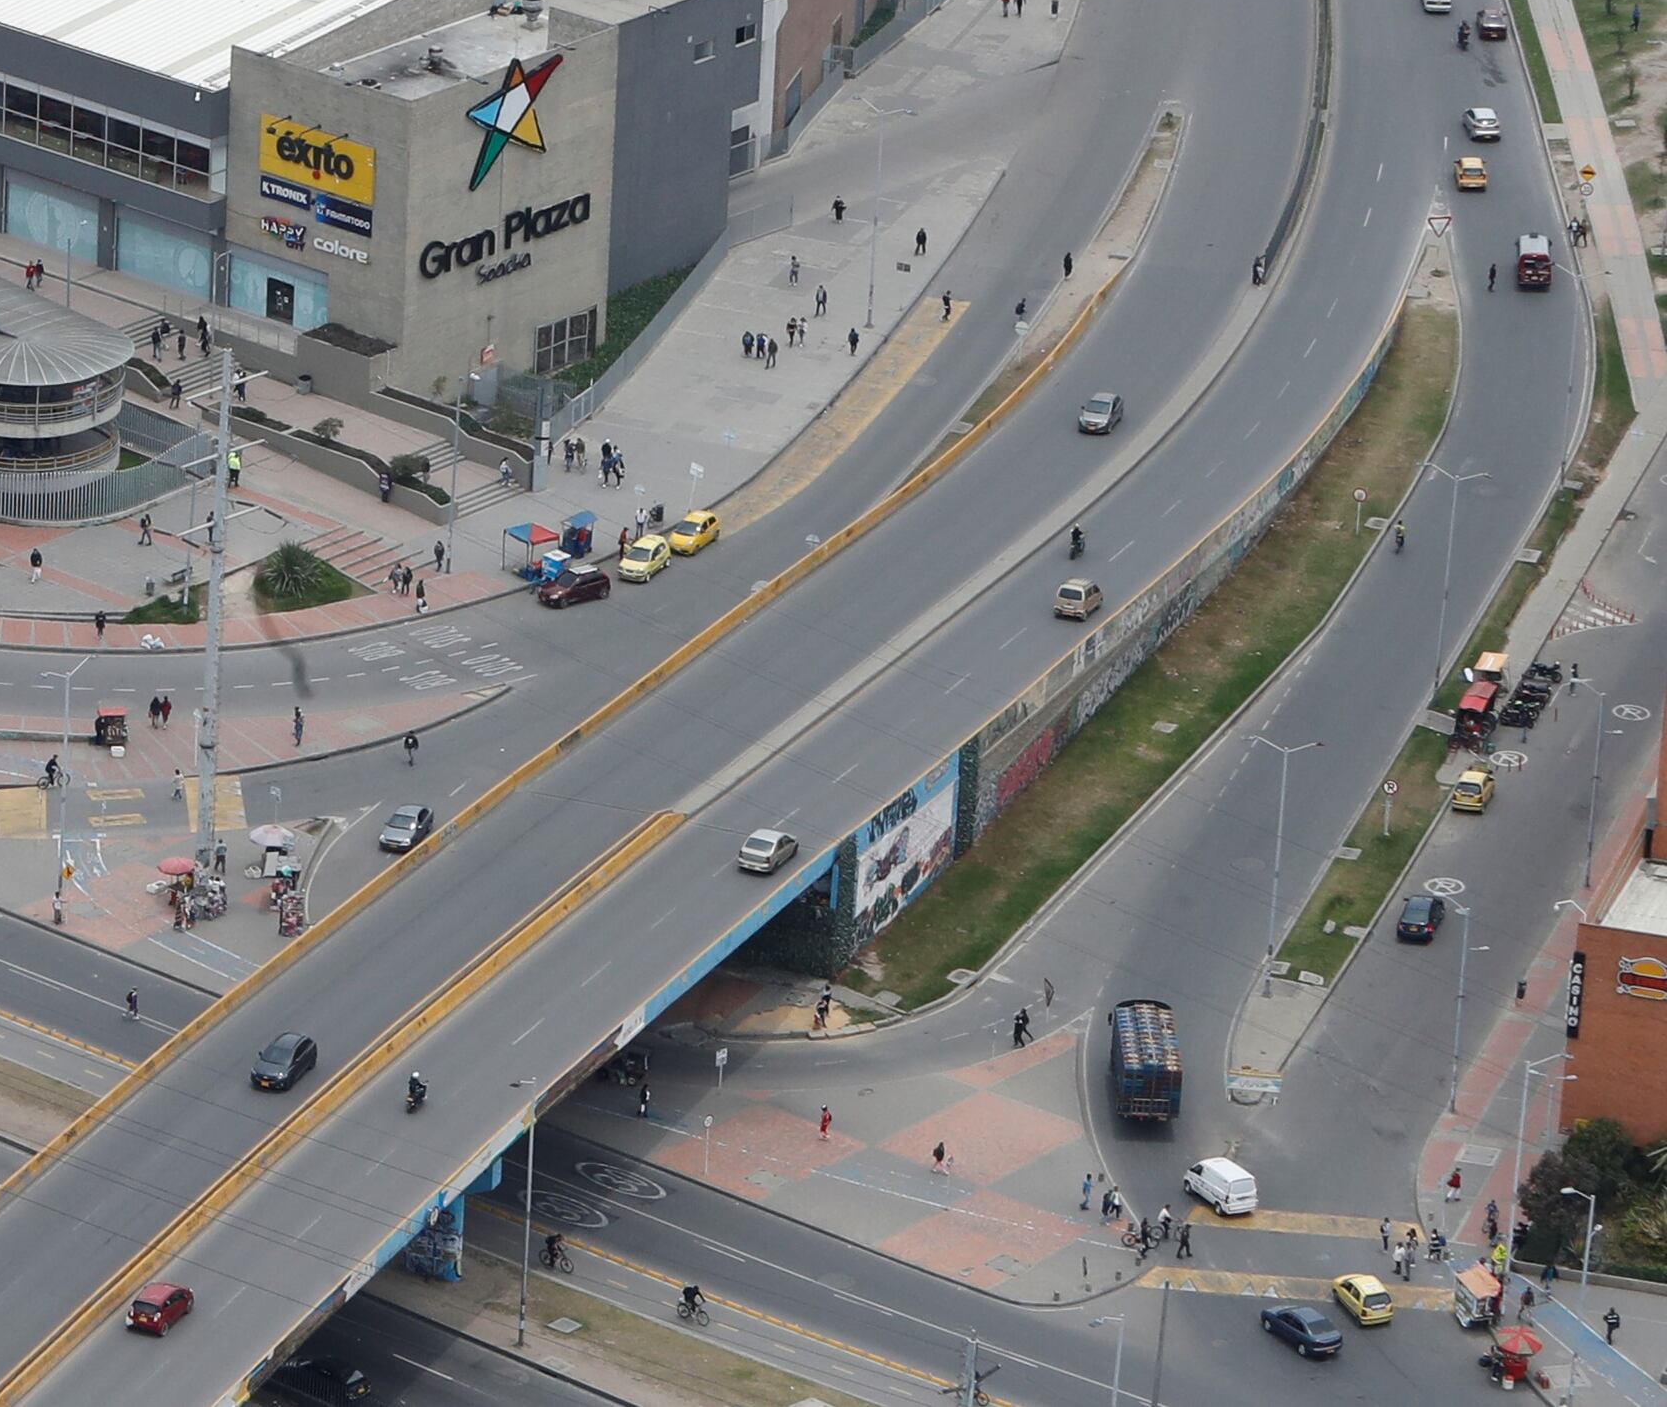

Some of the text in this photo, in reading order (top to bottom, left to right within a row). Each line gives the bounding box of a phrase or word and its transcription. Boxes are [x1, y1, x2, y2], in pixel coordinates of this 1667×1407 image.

[260, 218, 305, 241] HAPPY
[419, 192, 590, 280] Gran Plaza
[313, 235, 368, 264] colore
[475, 252, 532, 286] Soacha
[1567, 963, 1585, 1027] CASINO
